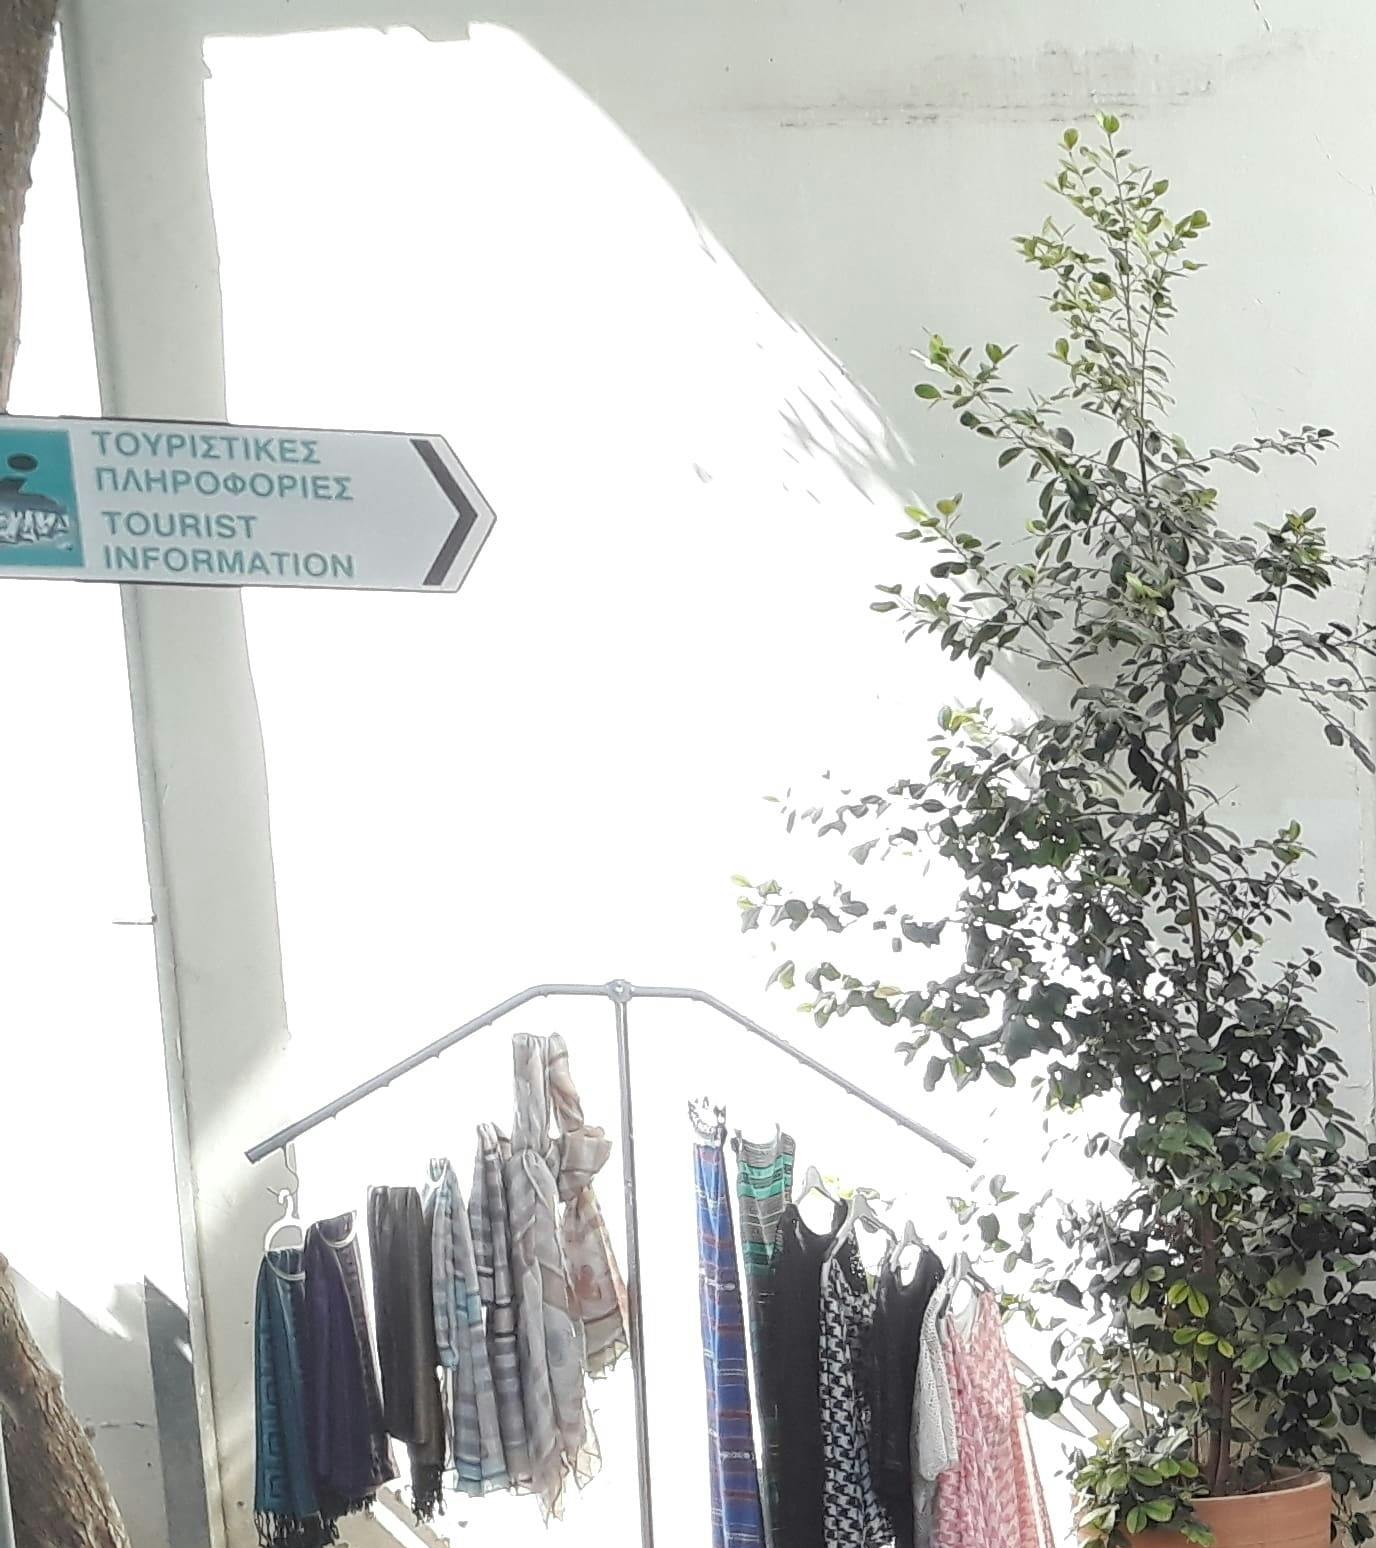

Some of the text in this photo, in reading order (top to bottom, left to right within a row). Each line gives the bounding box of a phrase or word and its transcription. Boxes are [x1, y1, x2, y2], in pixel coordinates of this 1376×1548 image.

[91, 429, 323, 465] ΤΟΥΡΙΣΤΙΚΕΣ
[95, 466, 355, 502] ΠΛΗΡΟΦΟΡΙΕΣ
[101, 509, 259, 540] TOURIST
[104, 546, 356, 579] INFORMATION
